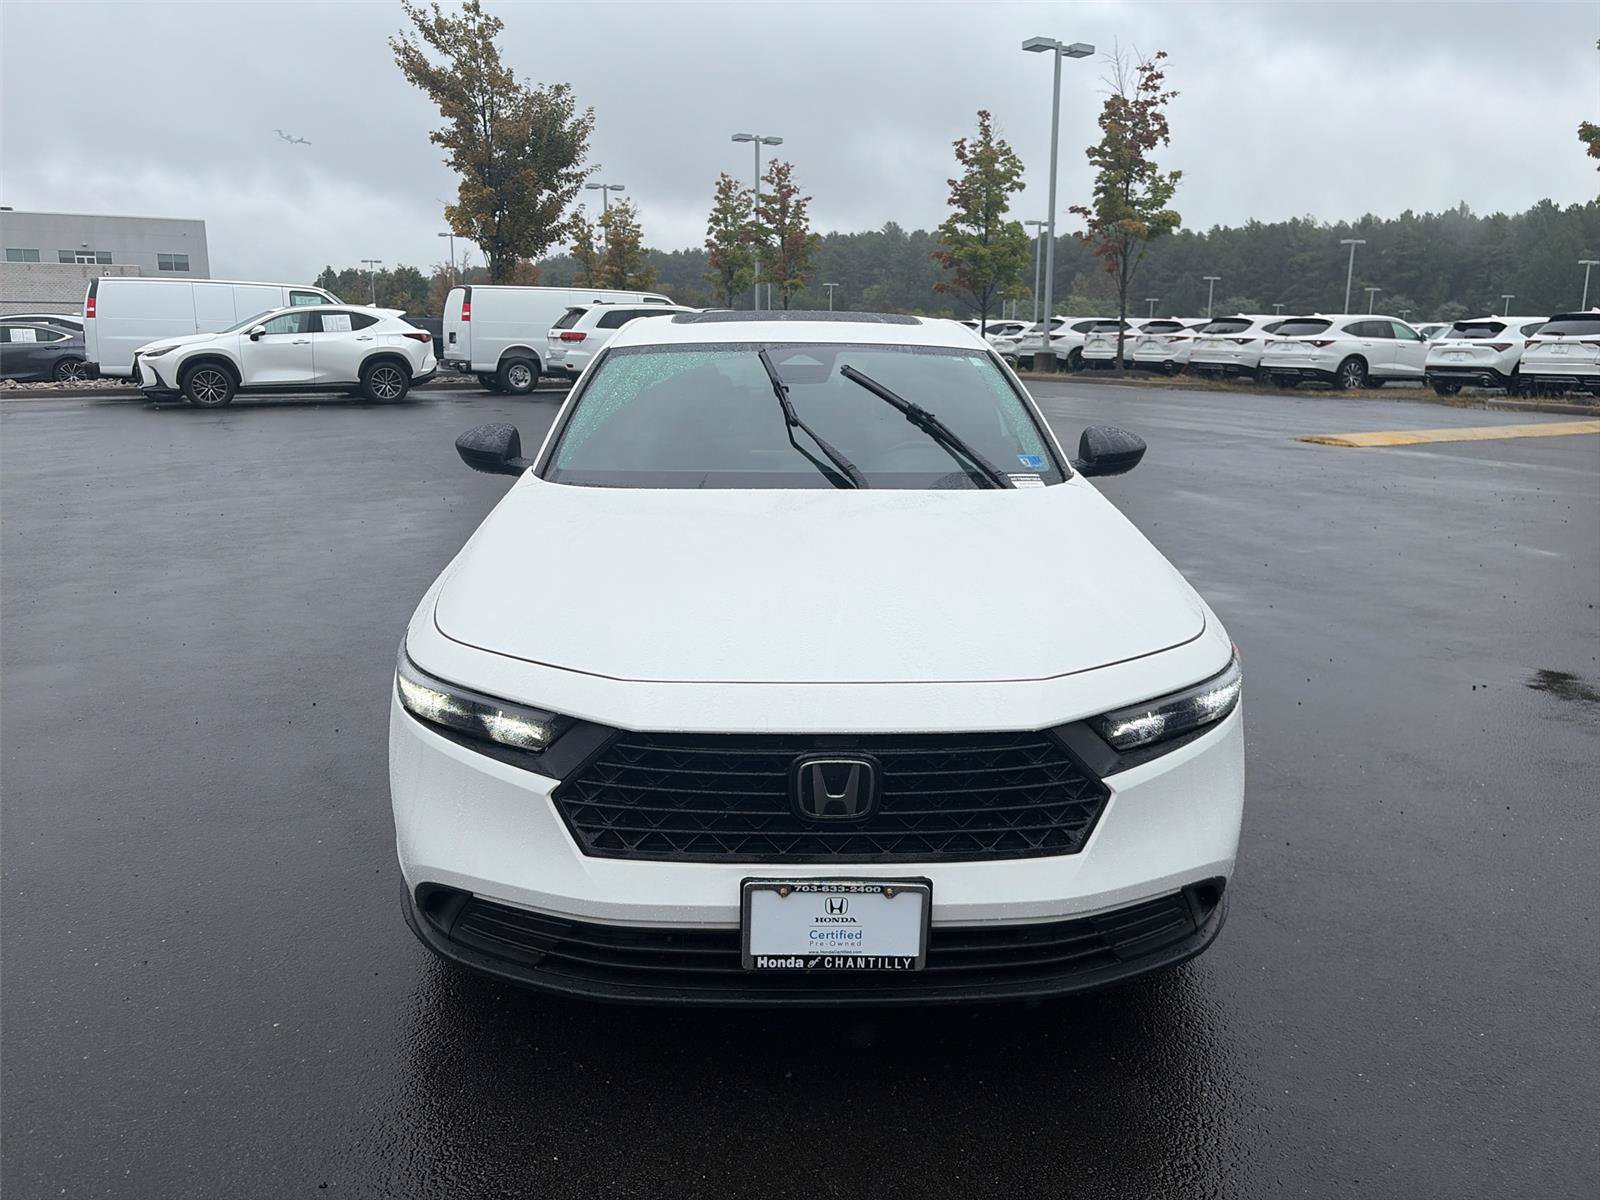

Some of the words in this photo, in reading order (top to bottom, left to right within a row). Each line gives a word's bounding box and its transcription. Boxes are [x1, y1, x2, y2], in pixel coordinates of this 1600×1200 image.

[794, 885, 882, 893] 703-633-2400
[809, 930, 863, 940] Certified
[757, 956, 804, 969] Honda
[807, 956, 822, 969] of
[824, 957, 913, 970] CHANTILLY
